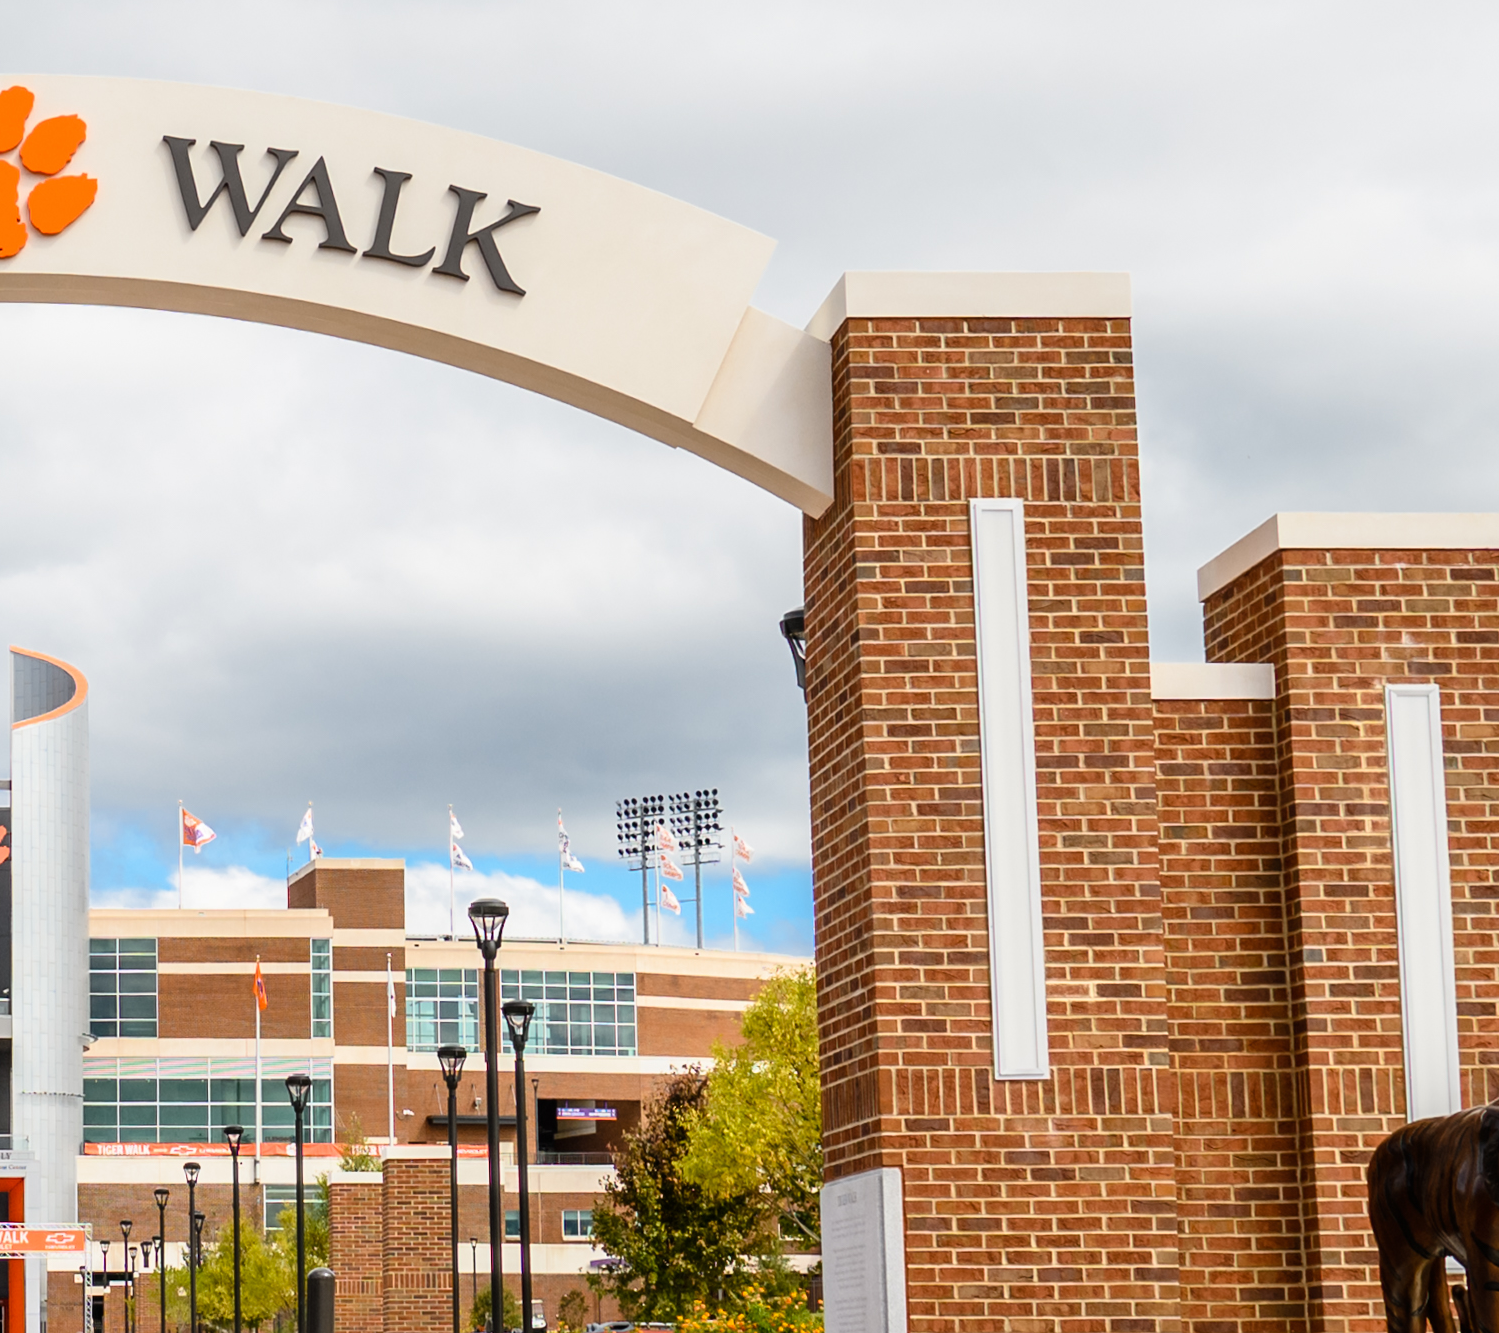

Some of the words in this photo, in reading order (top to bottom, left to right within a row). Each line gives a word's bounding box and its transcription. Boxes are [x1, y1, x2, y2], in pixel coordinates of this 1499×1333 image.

[162, 135, 541, 297] WALK
[97, 1144, 123, 1155] TIGER
[125, 1144, 150, 1155] WALK
